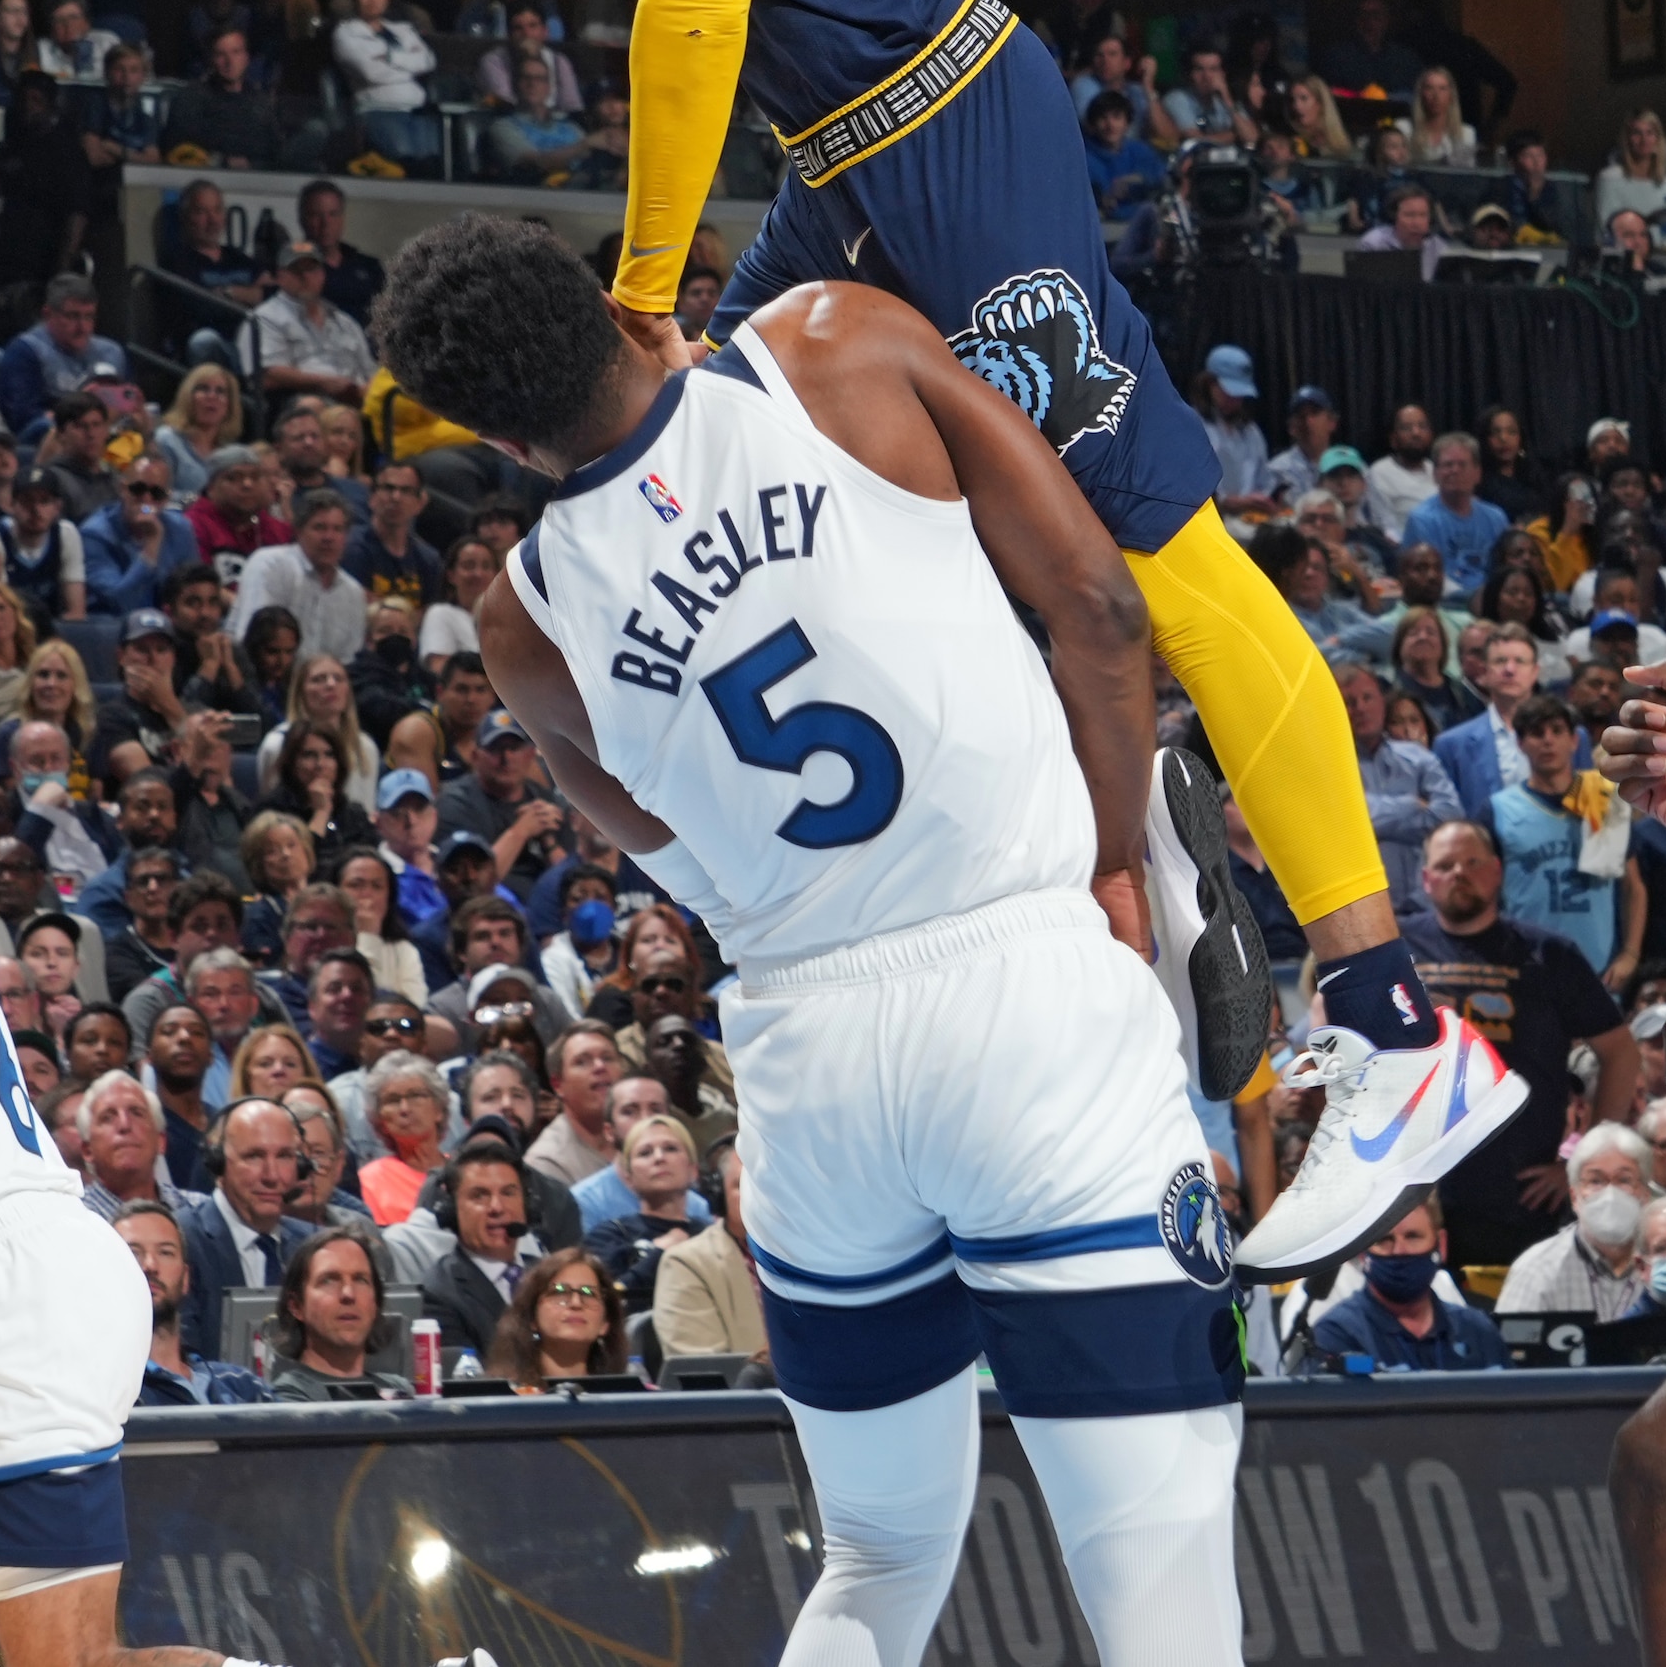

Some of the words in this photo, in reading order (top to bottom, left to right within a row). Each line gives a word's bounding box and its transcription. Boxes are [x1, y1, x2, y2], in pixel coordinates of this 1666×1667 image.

[613, 483, 827, 697] BEASLEY
[699, 619, 904, 849] 5
[1359, 1460, 1506, 1652] 10
